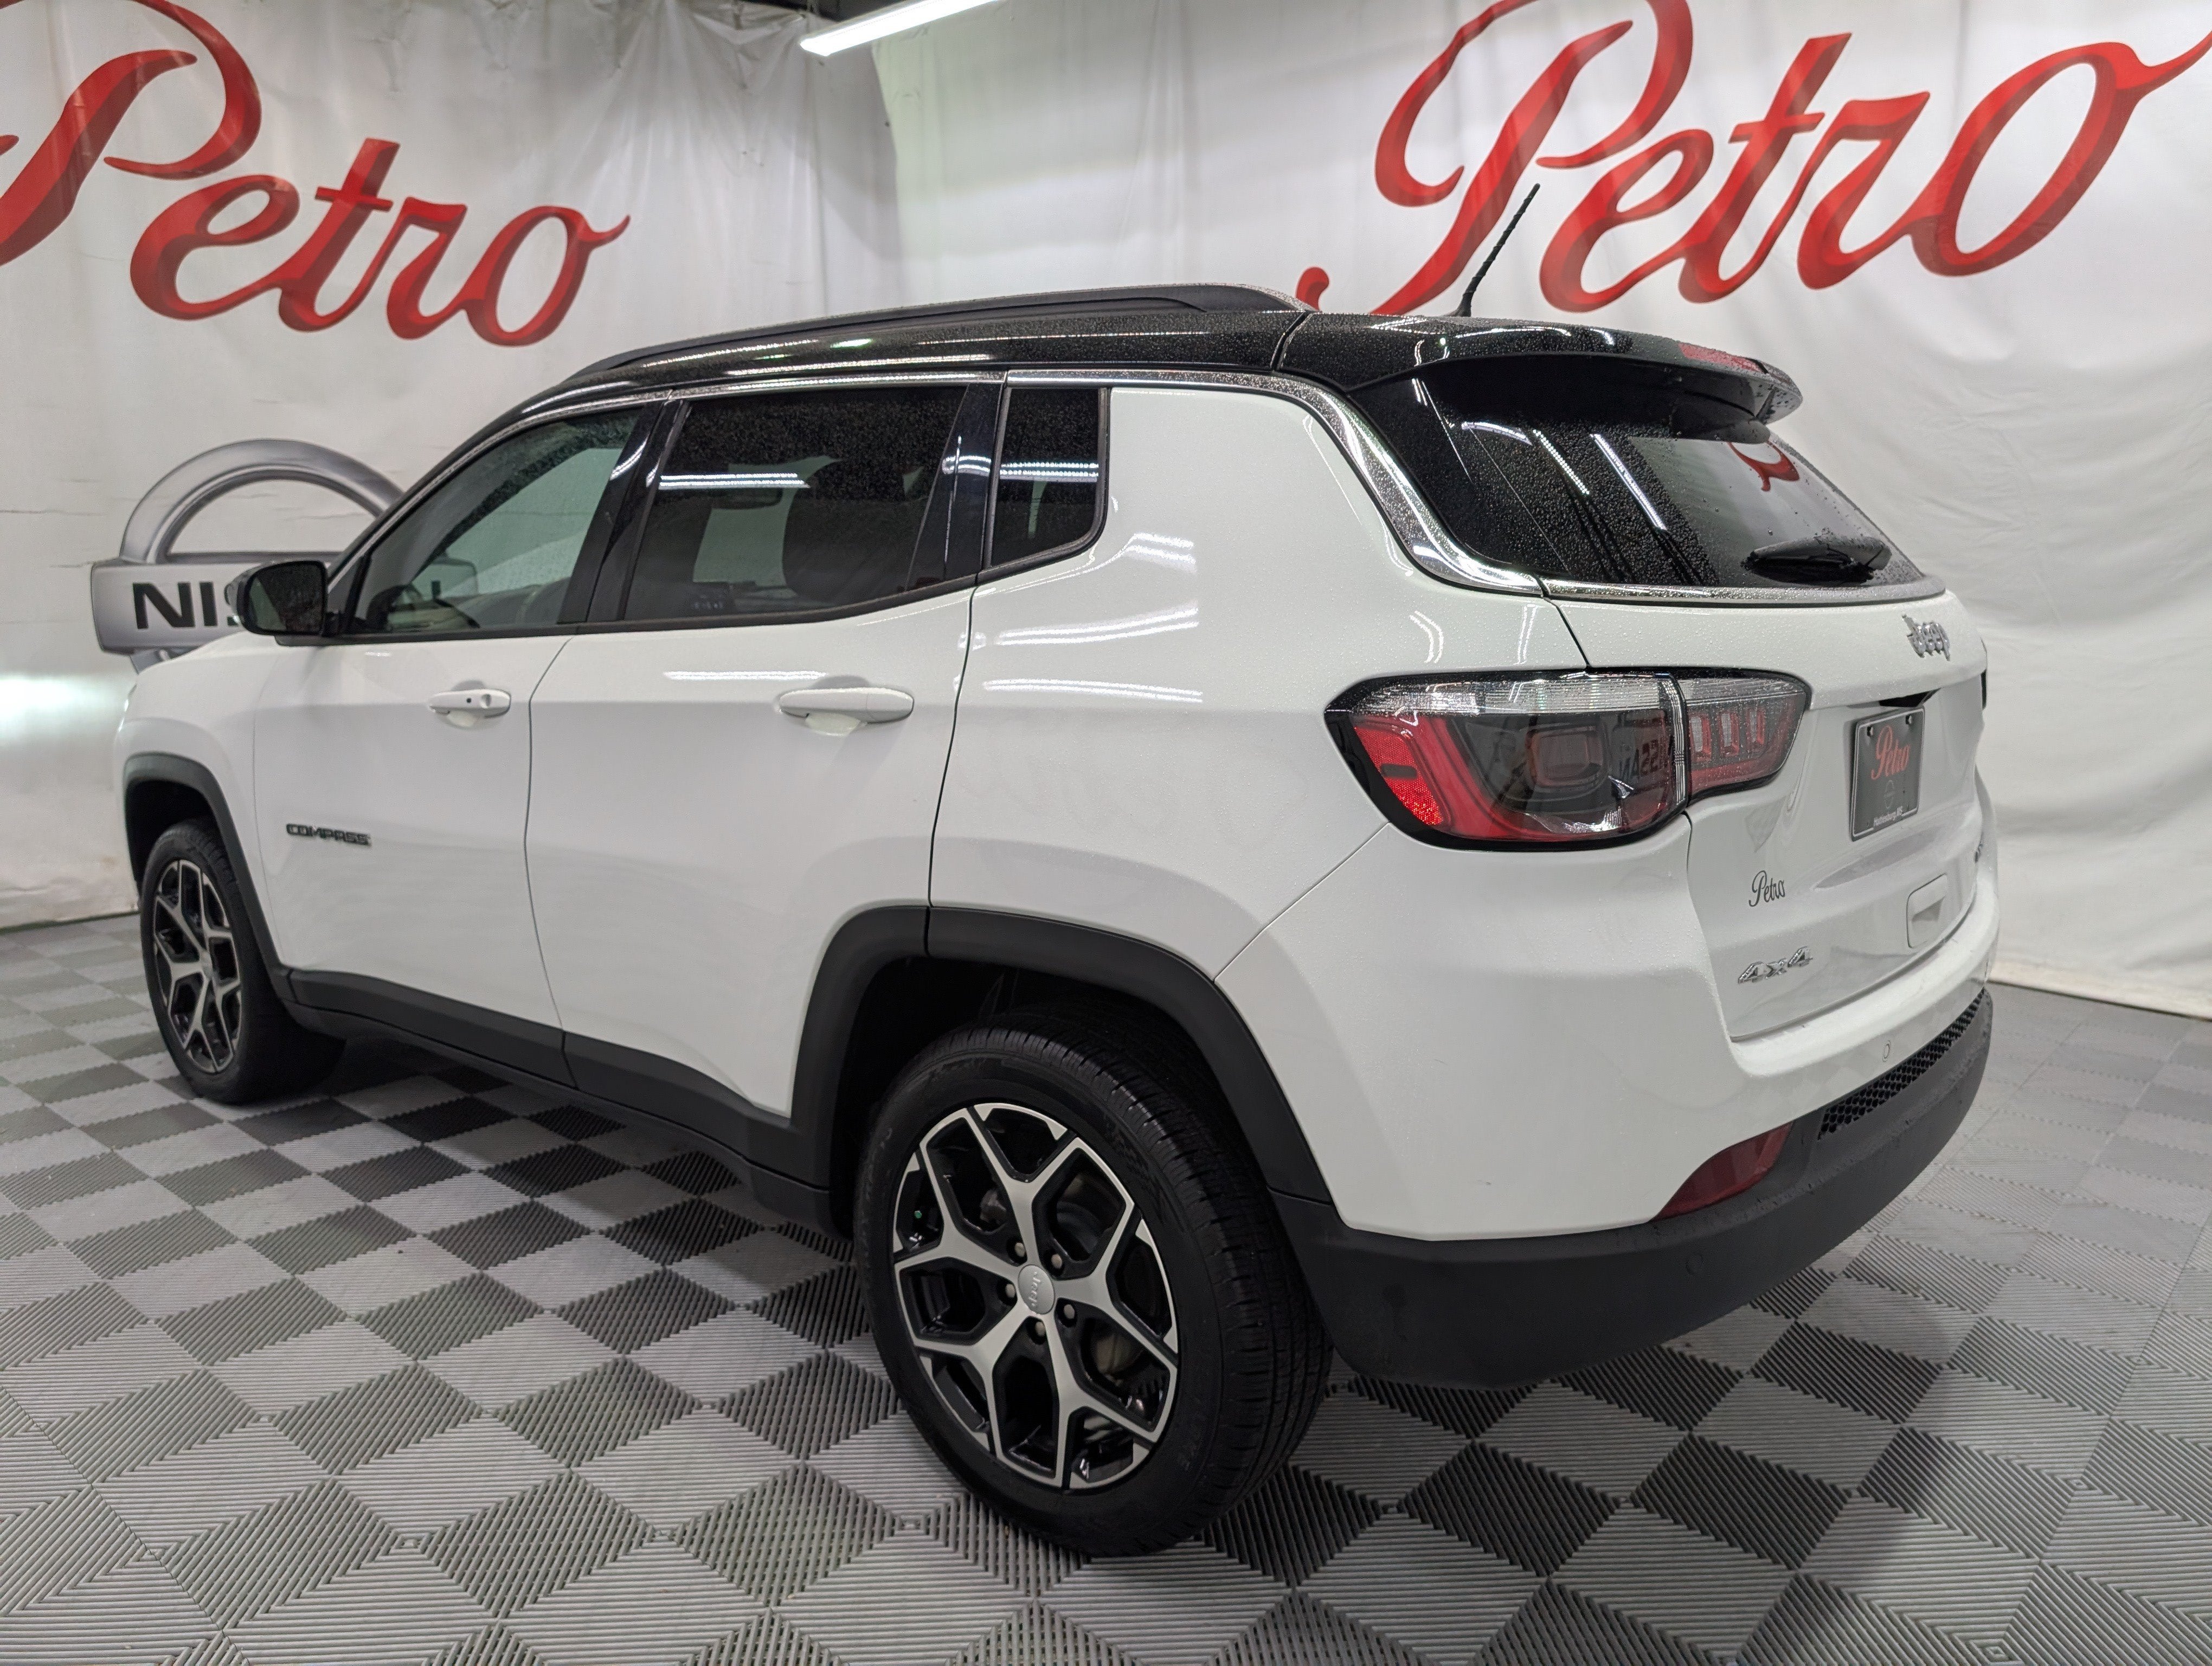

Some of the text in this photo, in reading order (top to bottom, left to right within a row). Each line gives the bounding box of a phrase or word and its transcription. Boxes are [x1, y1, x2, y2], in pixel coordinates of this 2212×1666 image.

[0, 0, 631, 347] Petro
[1296, 0, 2212, 317] Petro
[1902, 614, 1950, 661] Jeep
[1871, 725, 1911, 780] Petro
[1748, 870, 1785, 907] Petro
[1738, 946, 1813, 984] 4x4
[1028, 1271, 1041, 1307] Jeep
